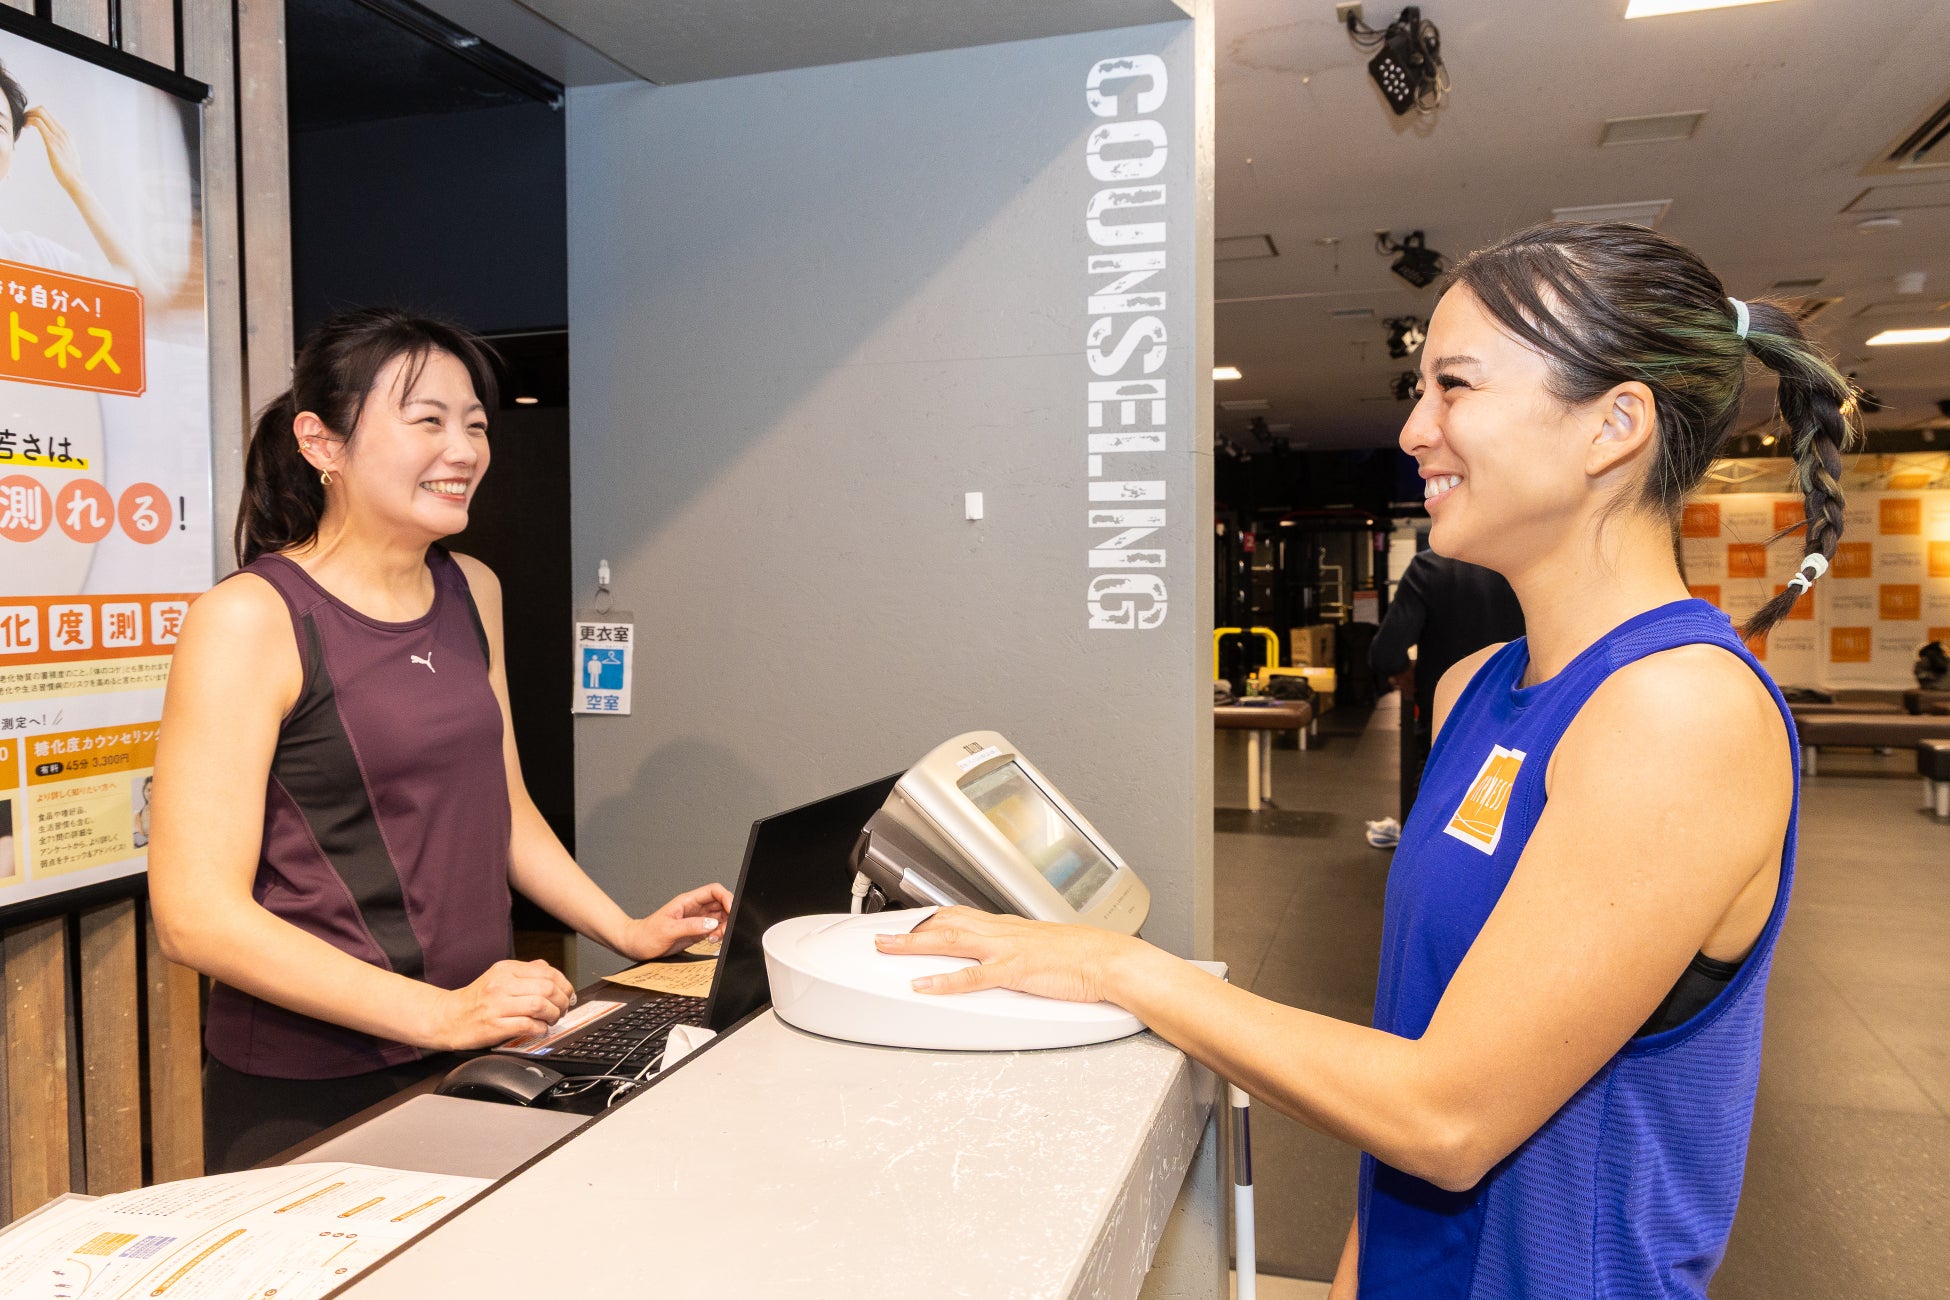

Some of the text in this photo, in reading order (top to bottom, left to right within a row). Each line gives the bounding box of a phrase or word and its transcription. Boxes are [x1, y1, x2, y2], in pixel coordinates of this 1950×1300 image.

[0, 280, 101, 318] な自分へ!
[9, 311, 122, 374] トネス
[1086, 54, 1168, 630] COUNSELING
[579, 625, 629, 642] 更衣室
[585, 694, 620, 711] 空室
